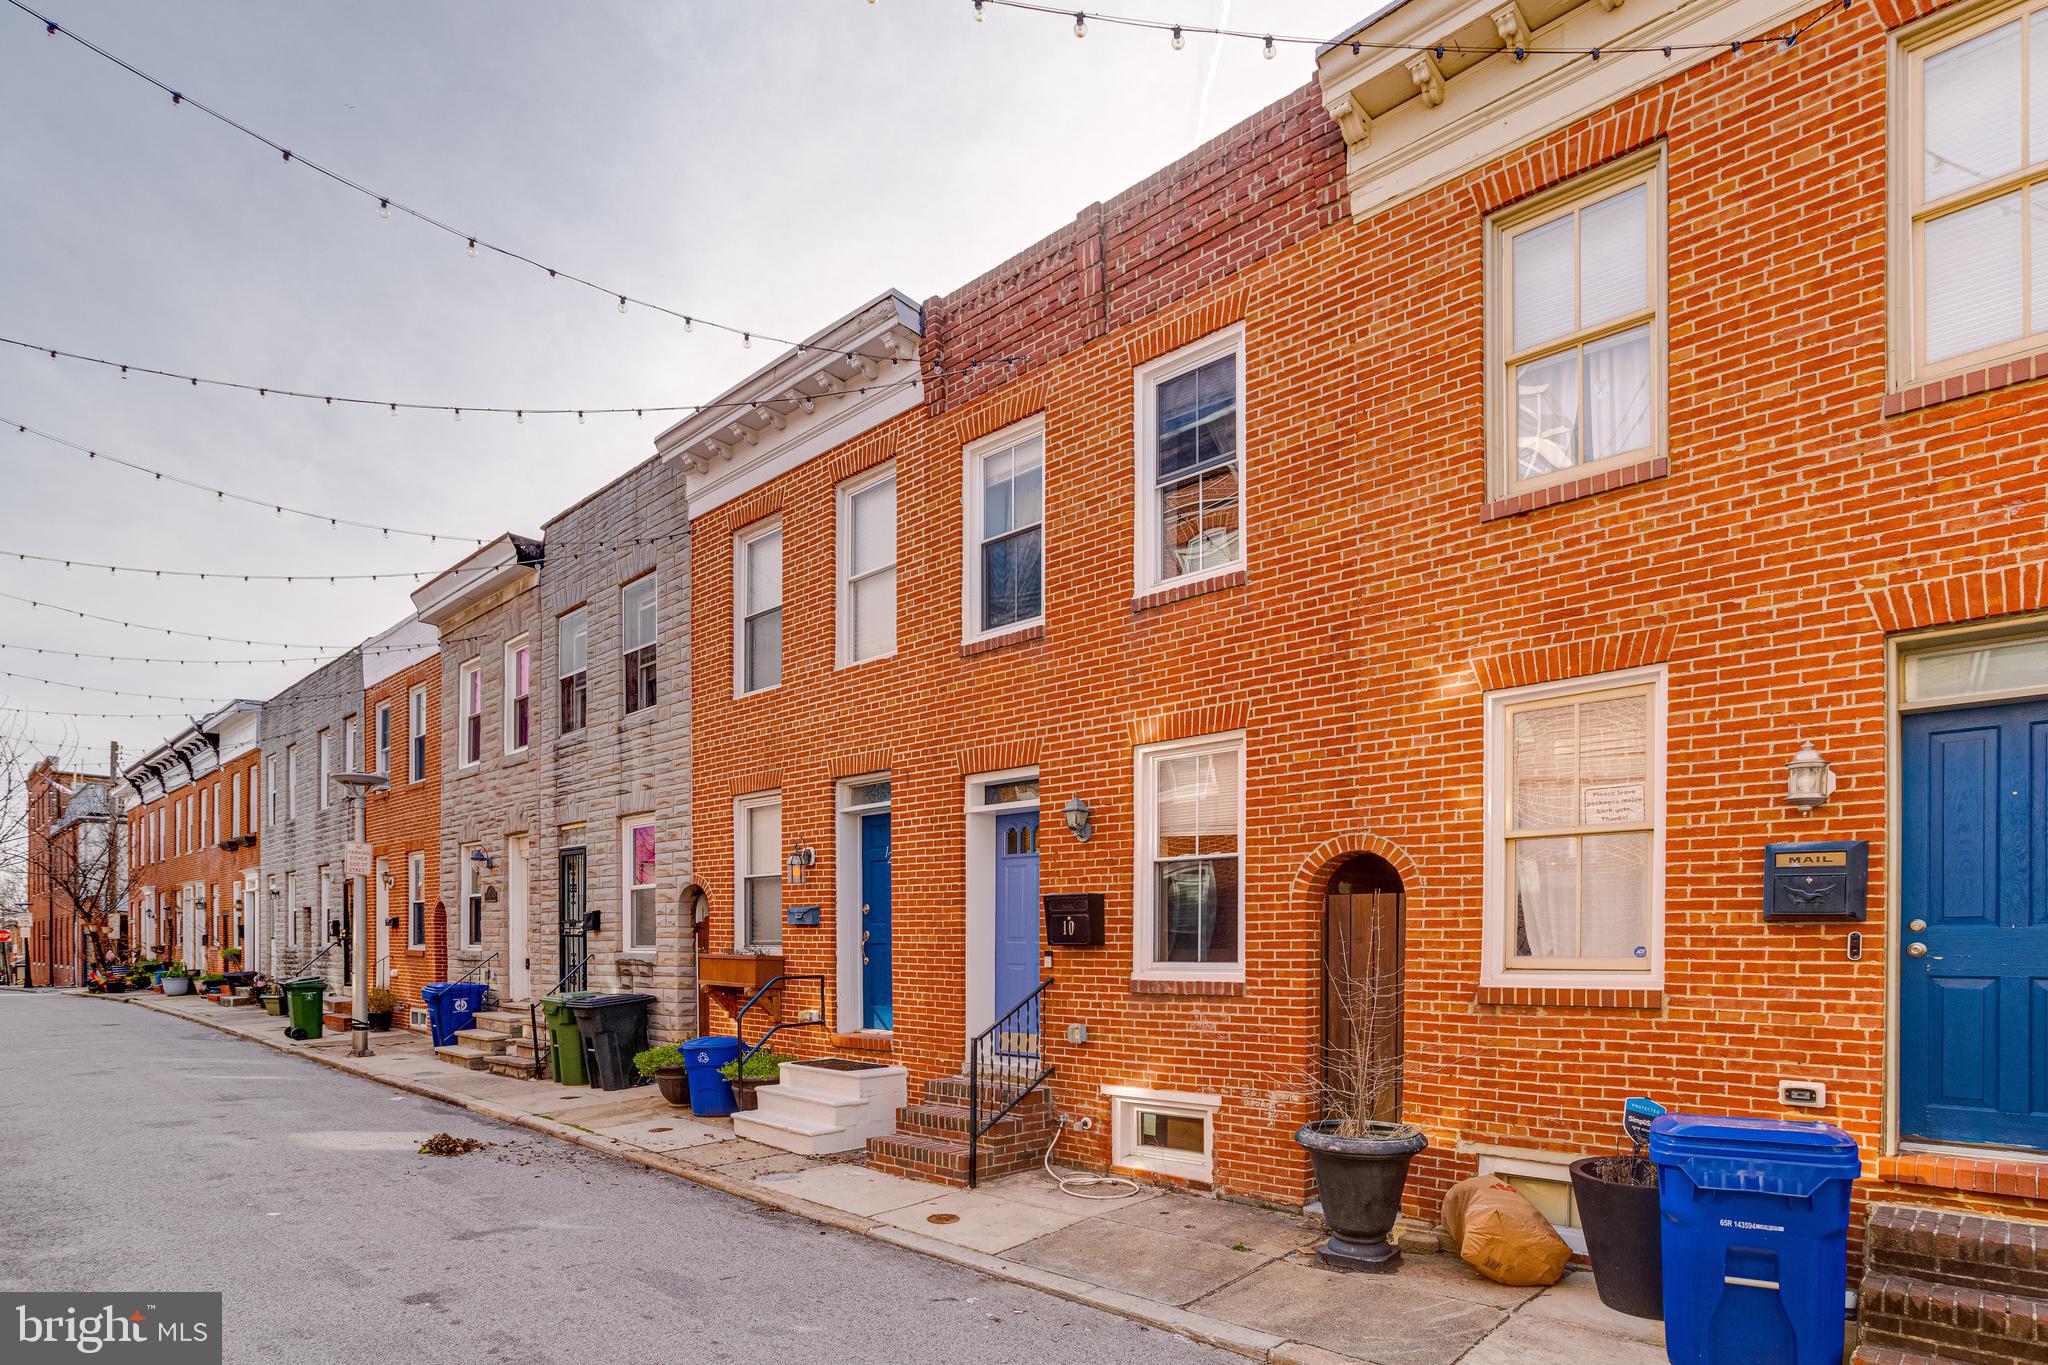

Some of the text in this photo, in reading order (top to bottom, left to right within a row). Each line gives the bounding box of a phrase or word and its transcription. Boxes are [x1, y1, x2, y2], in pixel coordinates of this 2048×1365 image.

[1788, 856, 1833, 864] MAIL
[1063, 920, 1075, 936] 10
[1631, 1103, 1661, 1115] PROTECTED
[1628, 1115, 1652, 1127] SimpliS
